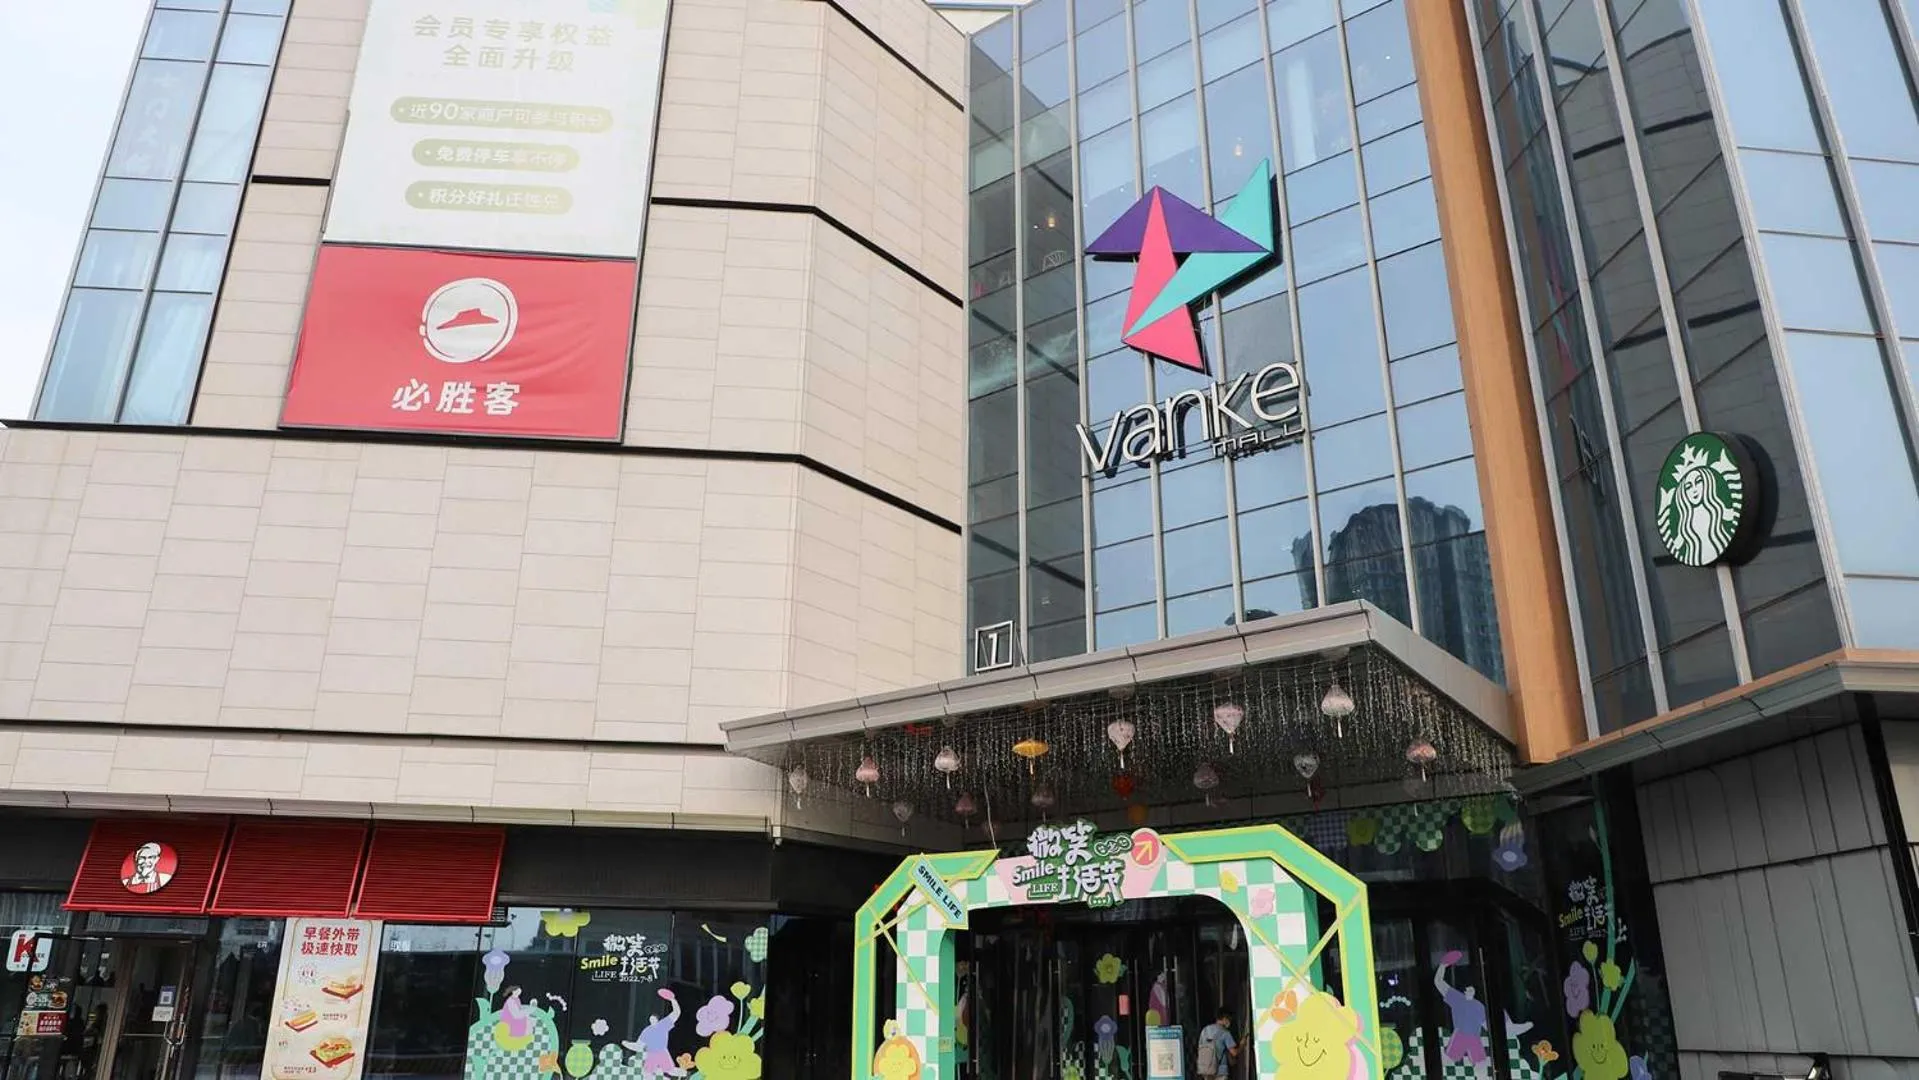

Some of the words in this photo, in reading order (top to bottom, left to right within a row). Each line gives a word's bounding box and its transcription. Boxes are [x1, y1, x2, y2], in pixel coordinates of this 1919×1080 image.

[413, 13, 614, 47] 会员专享权益
[442, 44, 575, 72] 全面升级
[391, 378, 520, 416] 必胜客
[1076, 362, 1300, 473] vanke
[1026, 820, 1094, 866] 微笑
[1012, 861, 1056, 884] Smile
[1057, 860, 1123, 903] 生活节
[918, 864, 944, 897] SMILE
[942, 895, 963, 919] LIFE
[1031, 882, 1059, 894] LIFE
[303, 926, 360, 941] 早餐外带
[301, 942, 359, 957] 极速快取
[580, 954, 619, 971] Smile
[594, 970, 618, 979] LIFE
